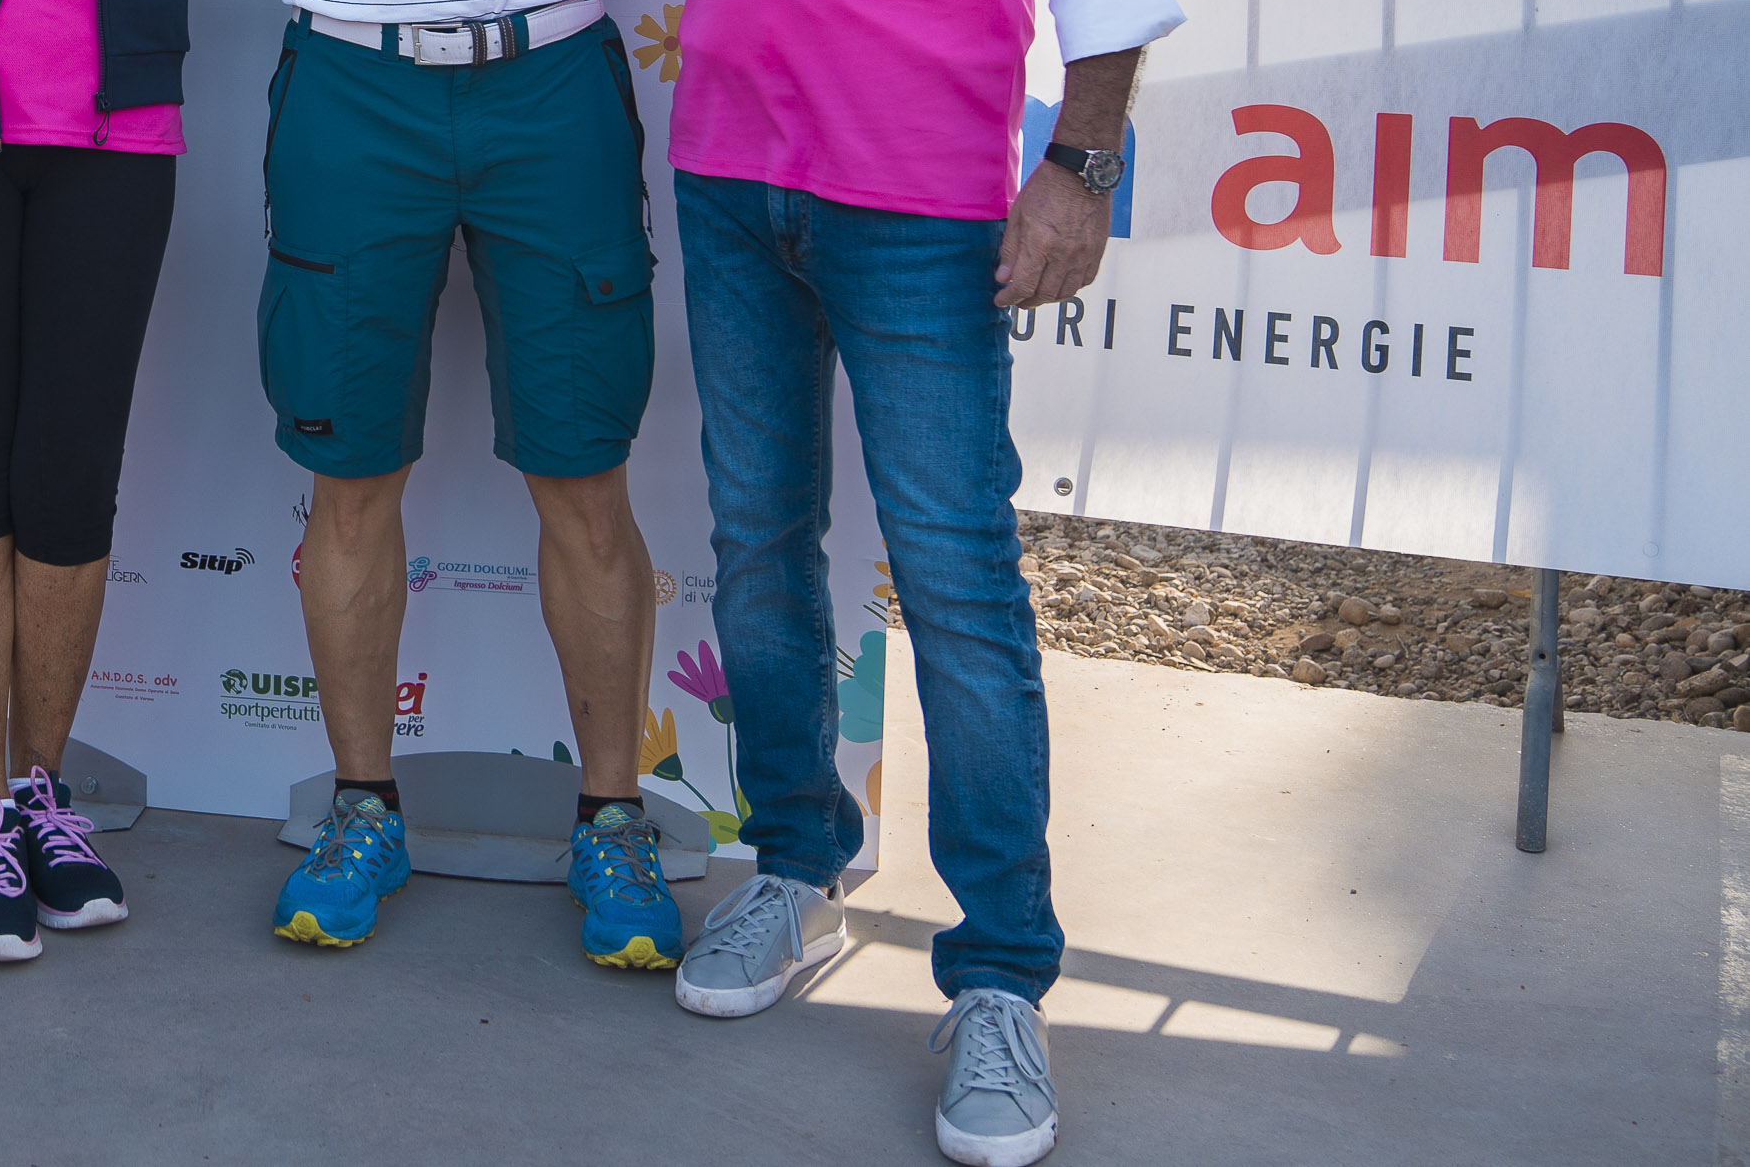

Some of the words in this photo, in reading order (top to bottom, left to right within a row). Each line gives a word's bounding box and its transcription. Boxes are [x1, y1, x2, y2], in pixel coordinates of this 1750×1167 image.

[1167, 303, 1476, 382] ENERGIE
[179, 551, 244, 575] Sitip
[437, 562, 471, 573] GOZZI
[474, 564, 528, 576] DOLCIUMI
[454, 579, 486, 590] Ingrosso
[488, 581, 524, 592] Dolciumi
[685, 576, 715, 588] Club
[684, 592, 696, 603] di
[91, 670, 148, 684] A.N.D.O.S.
[154, 674, 177, 687] odv
[251, 672, 318, 698] UISP
[395, 672, 427, 715] ei
[220, 702, 320, 722] sportpertutti
[408, 715, 425, 723] per
[244, 721, 270, 729] Comitato
[277, 723, 297, 731] Verona
